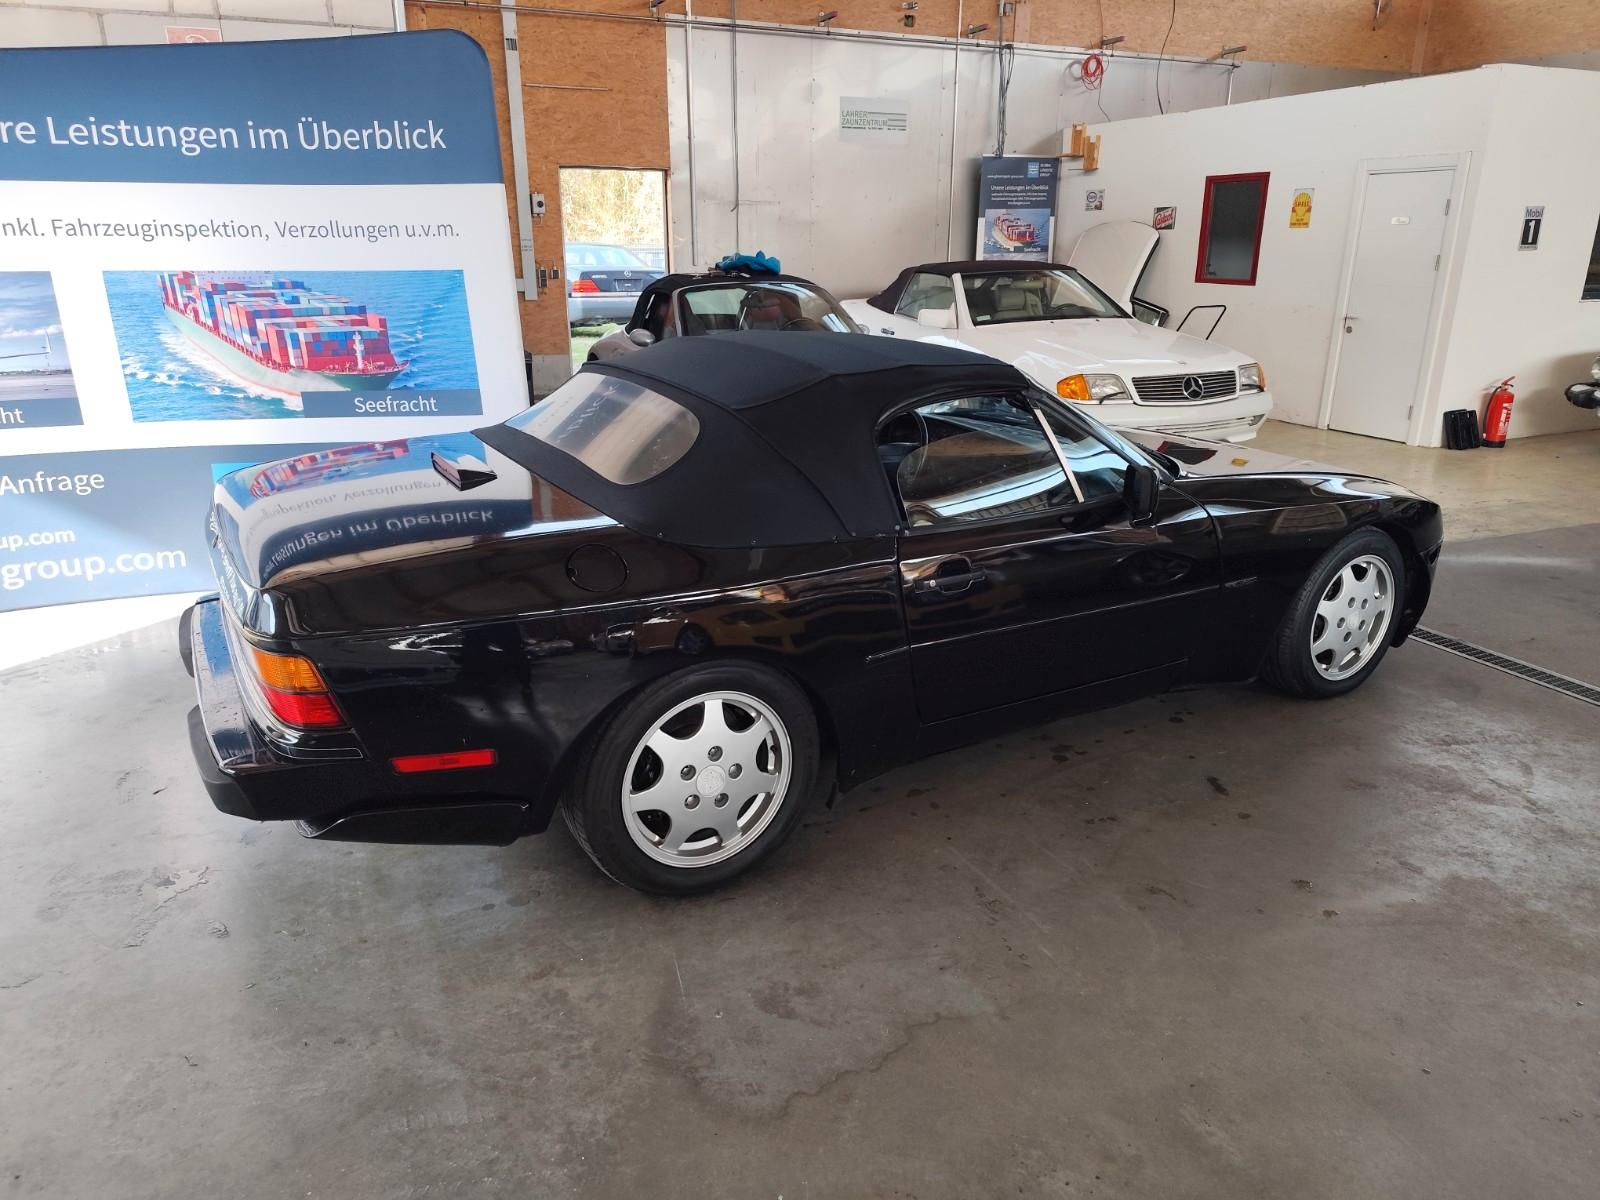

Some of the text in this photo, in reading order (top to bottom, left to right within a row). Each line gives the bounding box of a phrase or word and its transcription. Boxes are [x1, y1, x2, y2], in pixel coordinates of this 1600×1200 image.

[842, 110, 868, 119] LAHRER
[842, 118, 888, 127] ZAUNZENTRUM
[0, 116, 447, 156] re Leistungen im Überblick
[1525, 208, 1544, 218] Mobil
[2, 218, 460, 243] nkl. Fahrzeuginspektion, Verzollungen u.v.m.
[1528, 220, 1536, 243] 1
[354, 395, 439, 413] Seefracht
[0, 407, 25, 424] ht
[0, 471, 105, 496] Anfrage
[1, 549, 187, 590] group.com
